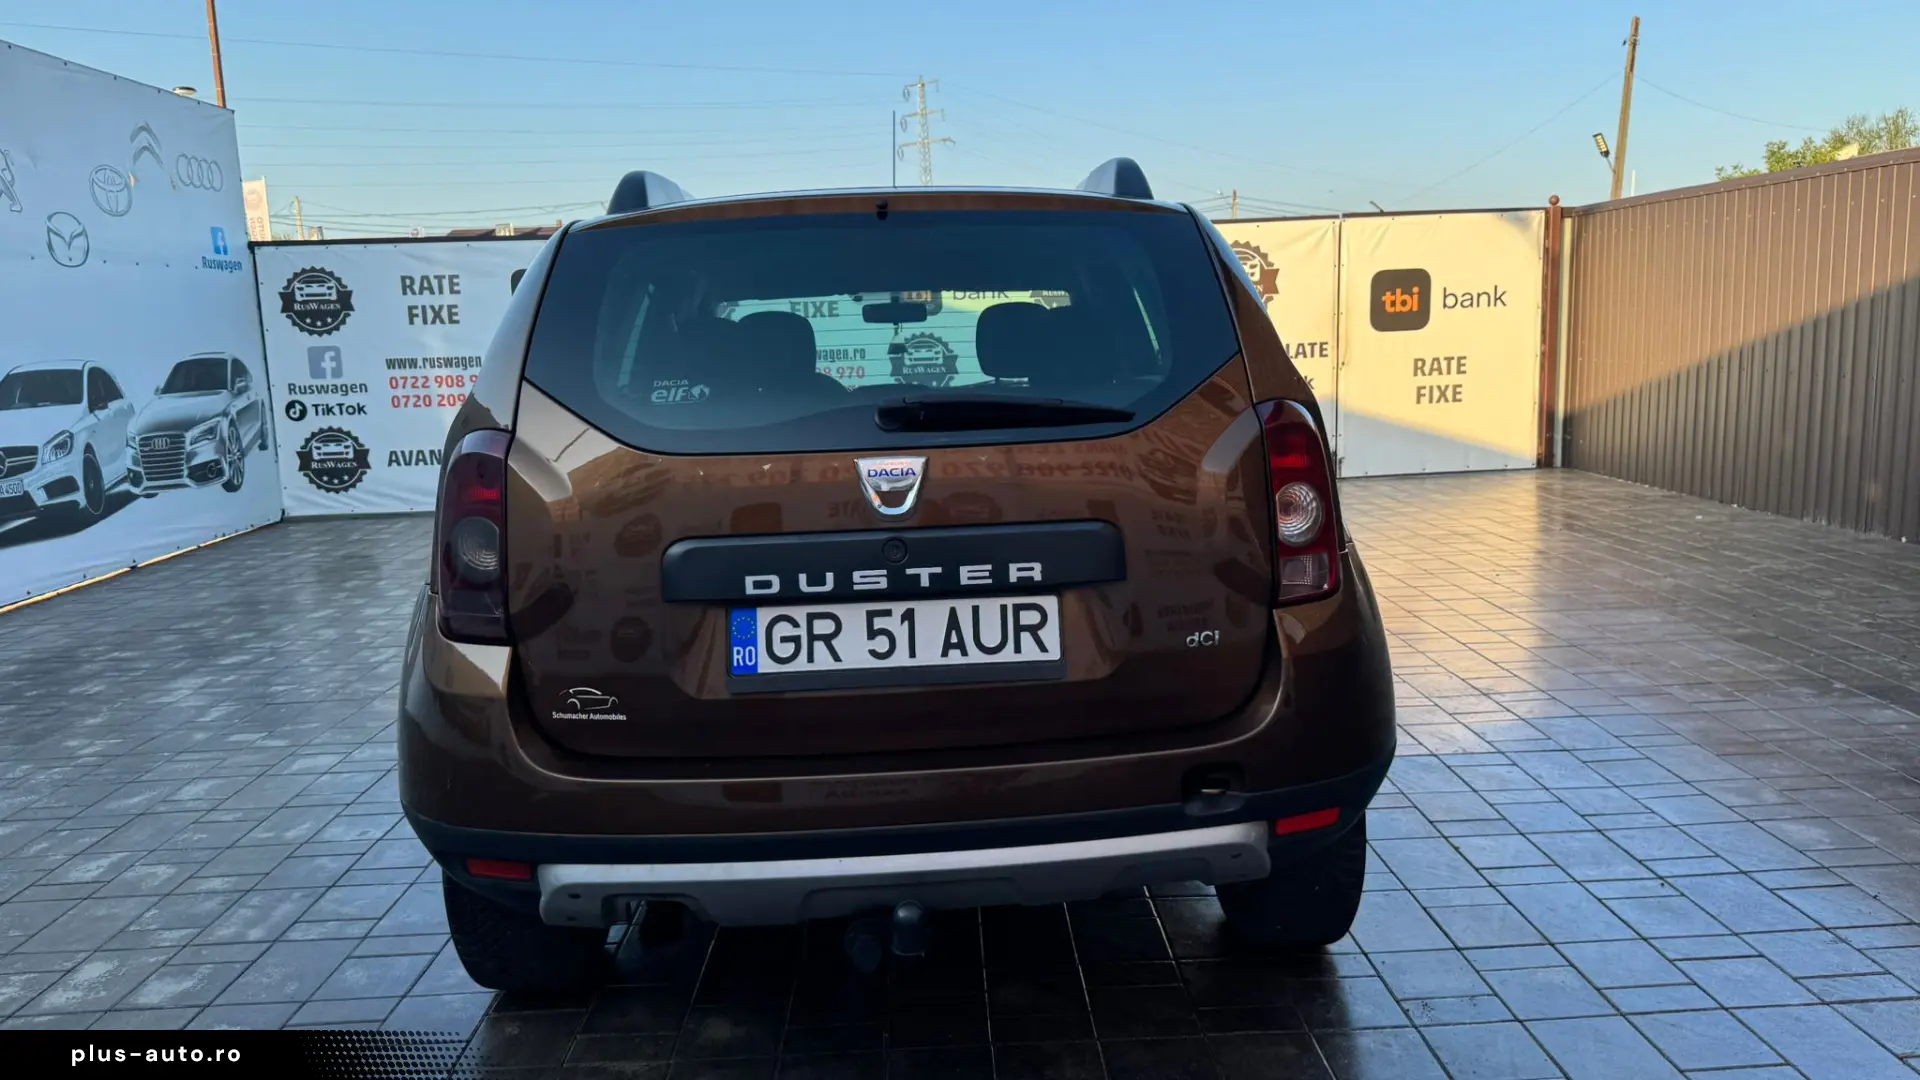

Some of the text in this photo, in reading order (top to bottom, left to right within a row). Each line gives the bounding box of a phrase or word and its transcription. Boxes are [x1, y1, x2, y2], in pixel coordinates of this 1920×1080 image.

[202, 256, 243, 273] Ruswagen
[400, 274, 461, 296] RATE
[1382, 285, 1507, 313] tbi bank
[407, 304, 460, 325] FIXE
[789, 300, 840, 318] FIXE
[386, 356, 482, 371] www.ruswagen
[1413, 356, 1467, 377] RATE
[836, 366, 866, 379] 970
[288, 382, 368, 396] Ruswagen
[389, 376, 430, 390] 0722
[435, 374, 465, 388] 908
[653, 379, 689, 388] DACIA
[391, 394, 466, 408] 0720 209
[651, 387, 689, 402] elf
[1416, 384, 1463, 405] FIXE
[312, 403, 368, 417] TikTok
[867, 467, 916, 478] DACIA
[745, 562, 1042, 595] DUSTER
[765, 603, 1049, 664] GR 51 AUR
[733, 647, 756, 665] RO
[552, 711, 627, 720] Schumacher Automobiles
